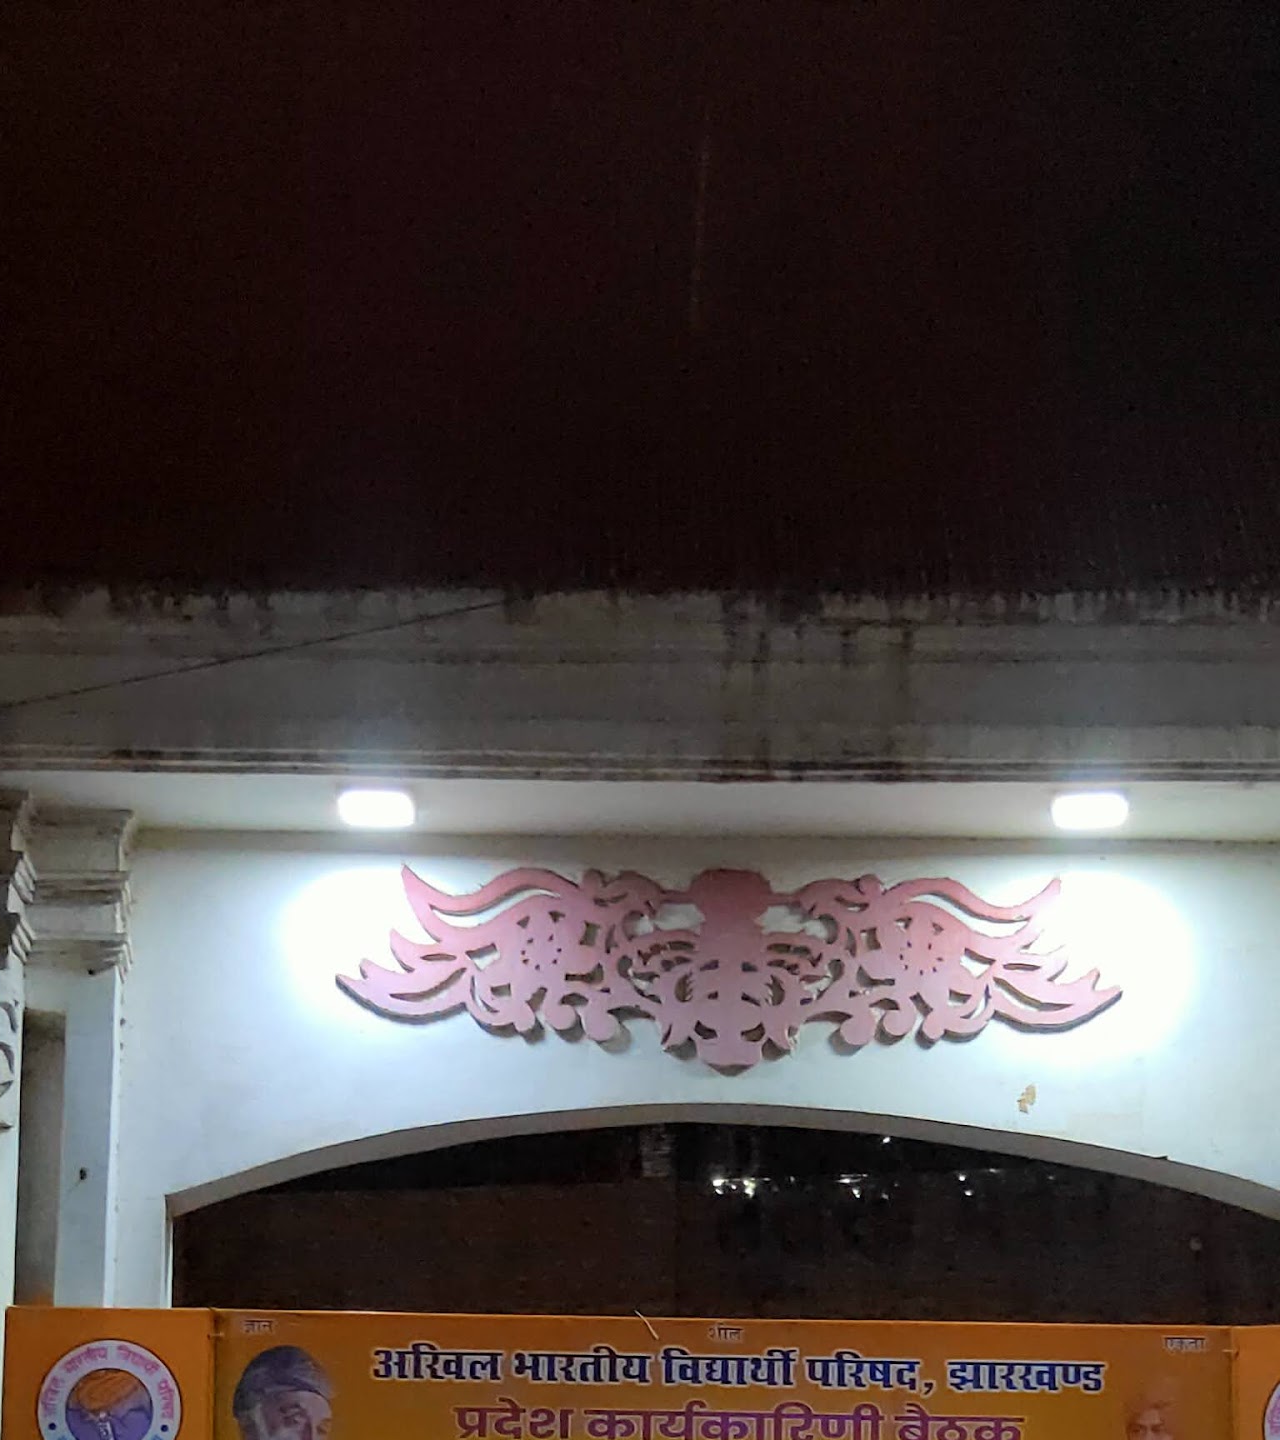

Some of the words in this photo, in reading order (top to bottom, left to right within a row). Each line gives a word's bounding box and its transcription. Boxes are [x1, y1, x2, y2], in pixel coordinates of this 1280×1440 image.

[373, 1344, 501, 1382] अखिल
[514, 1345, 652, 1387] भारतीय
[660, 1347, 797, 1388] विद्यार्थी
[805, 1352, 935, 1396] परिषद,
[946, 1360, 1108, 1394] झारखण्ड
